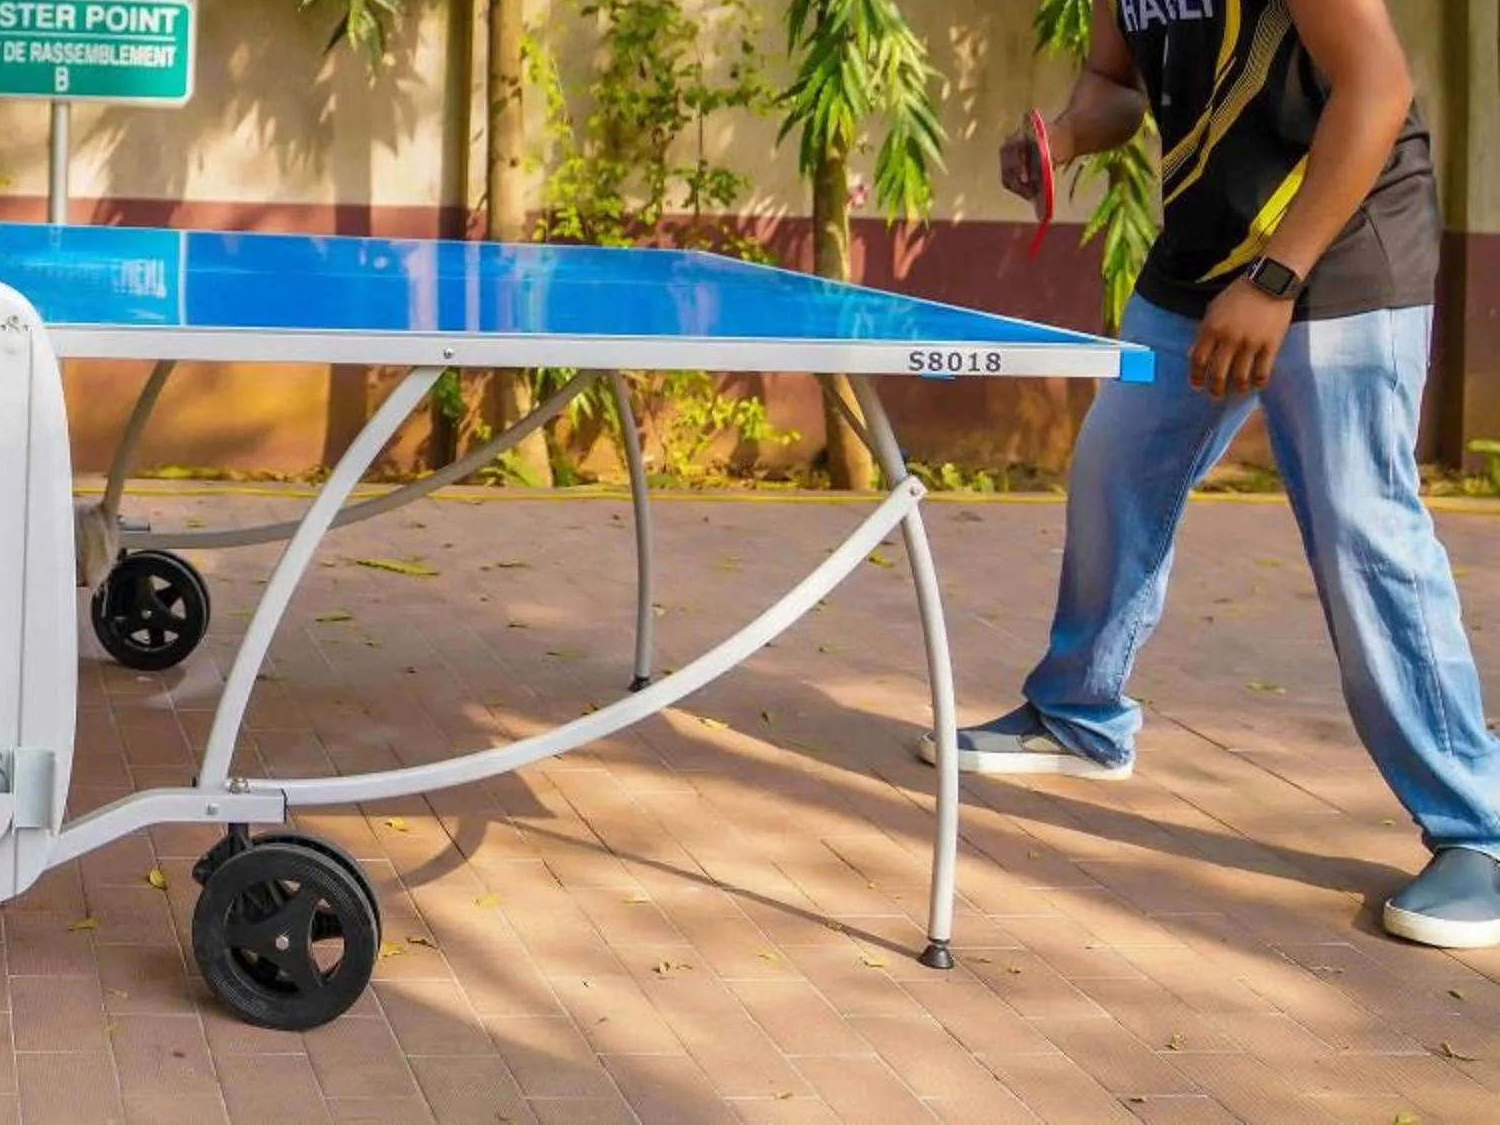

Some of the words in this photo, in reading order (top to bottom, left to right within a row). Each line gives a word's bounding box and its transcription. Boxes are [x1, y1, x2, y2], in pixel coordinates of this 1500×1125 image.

[87, 5, 179, 33] POINT
[3, 41, 26, 63] DE
[30, 43, 176, 67] RASSEMBLEMENT
[55, 67, 69, 92] B
[909, 352, 1001, 372] S8018
